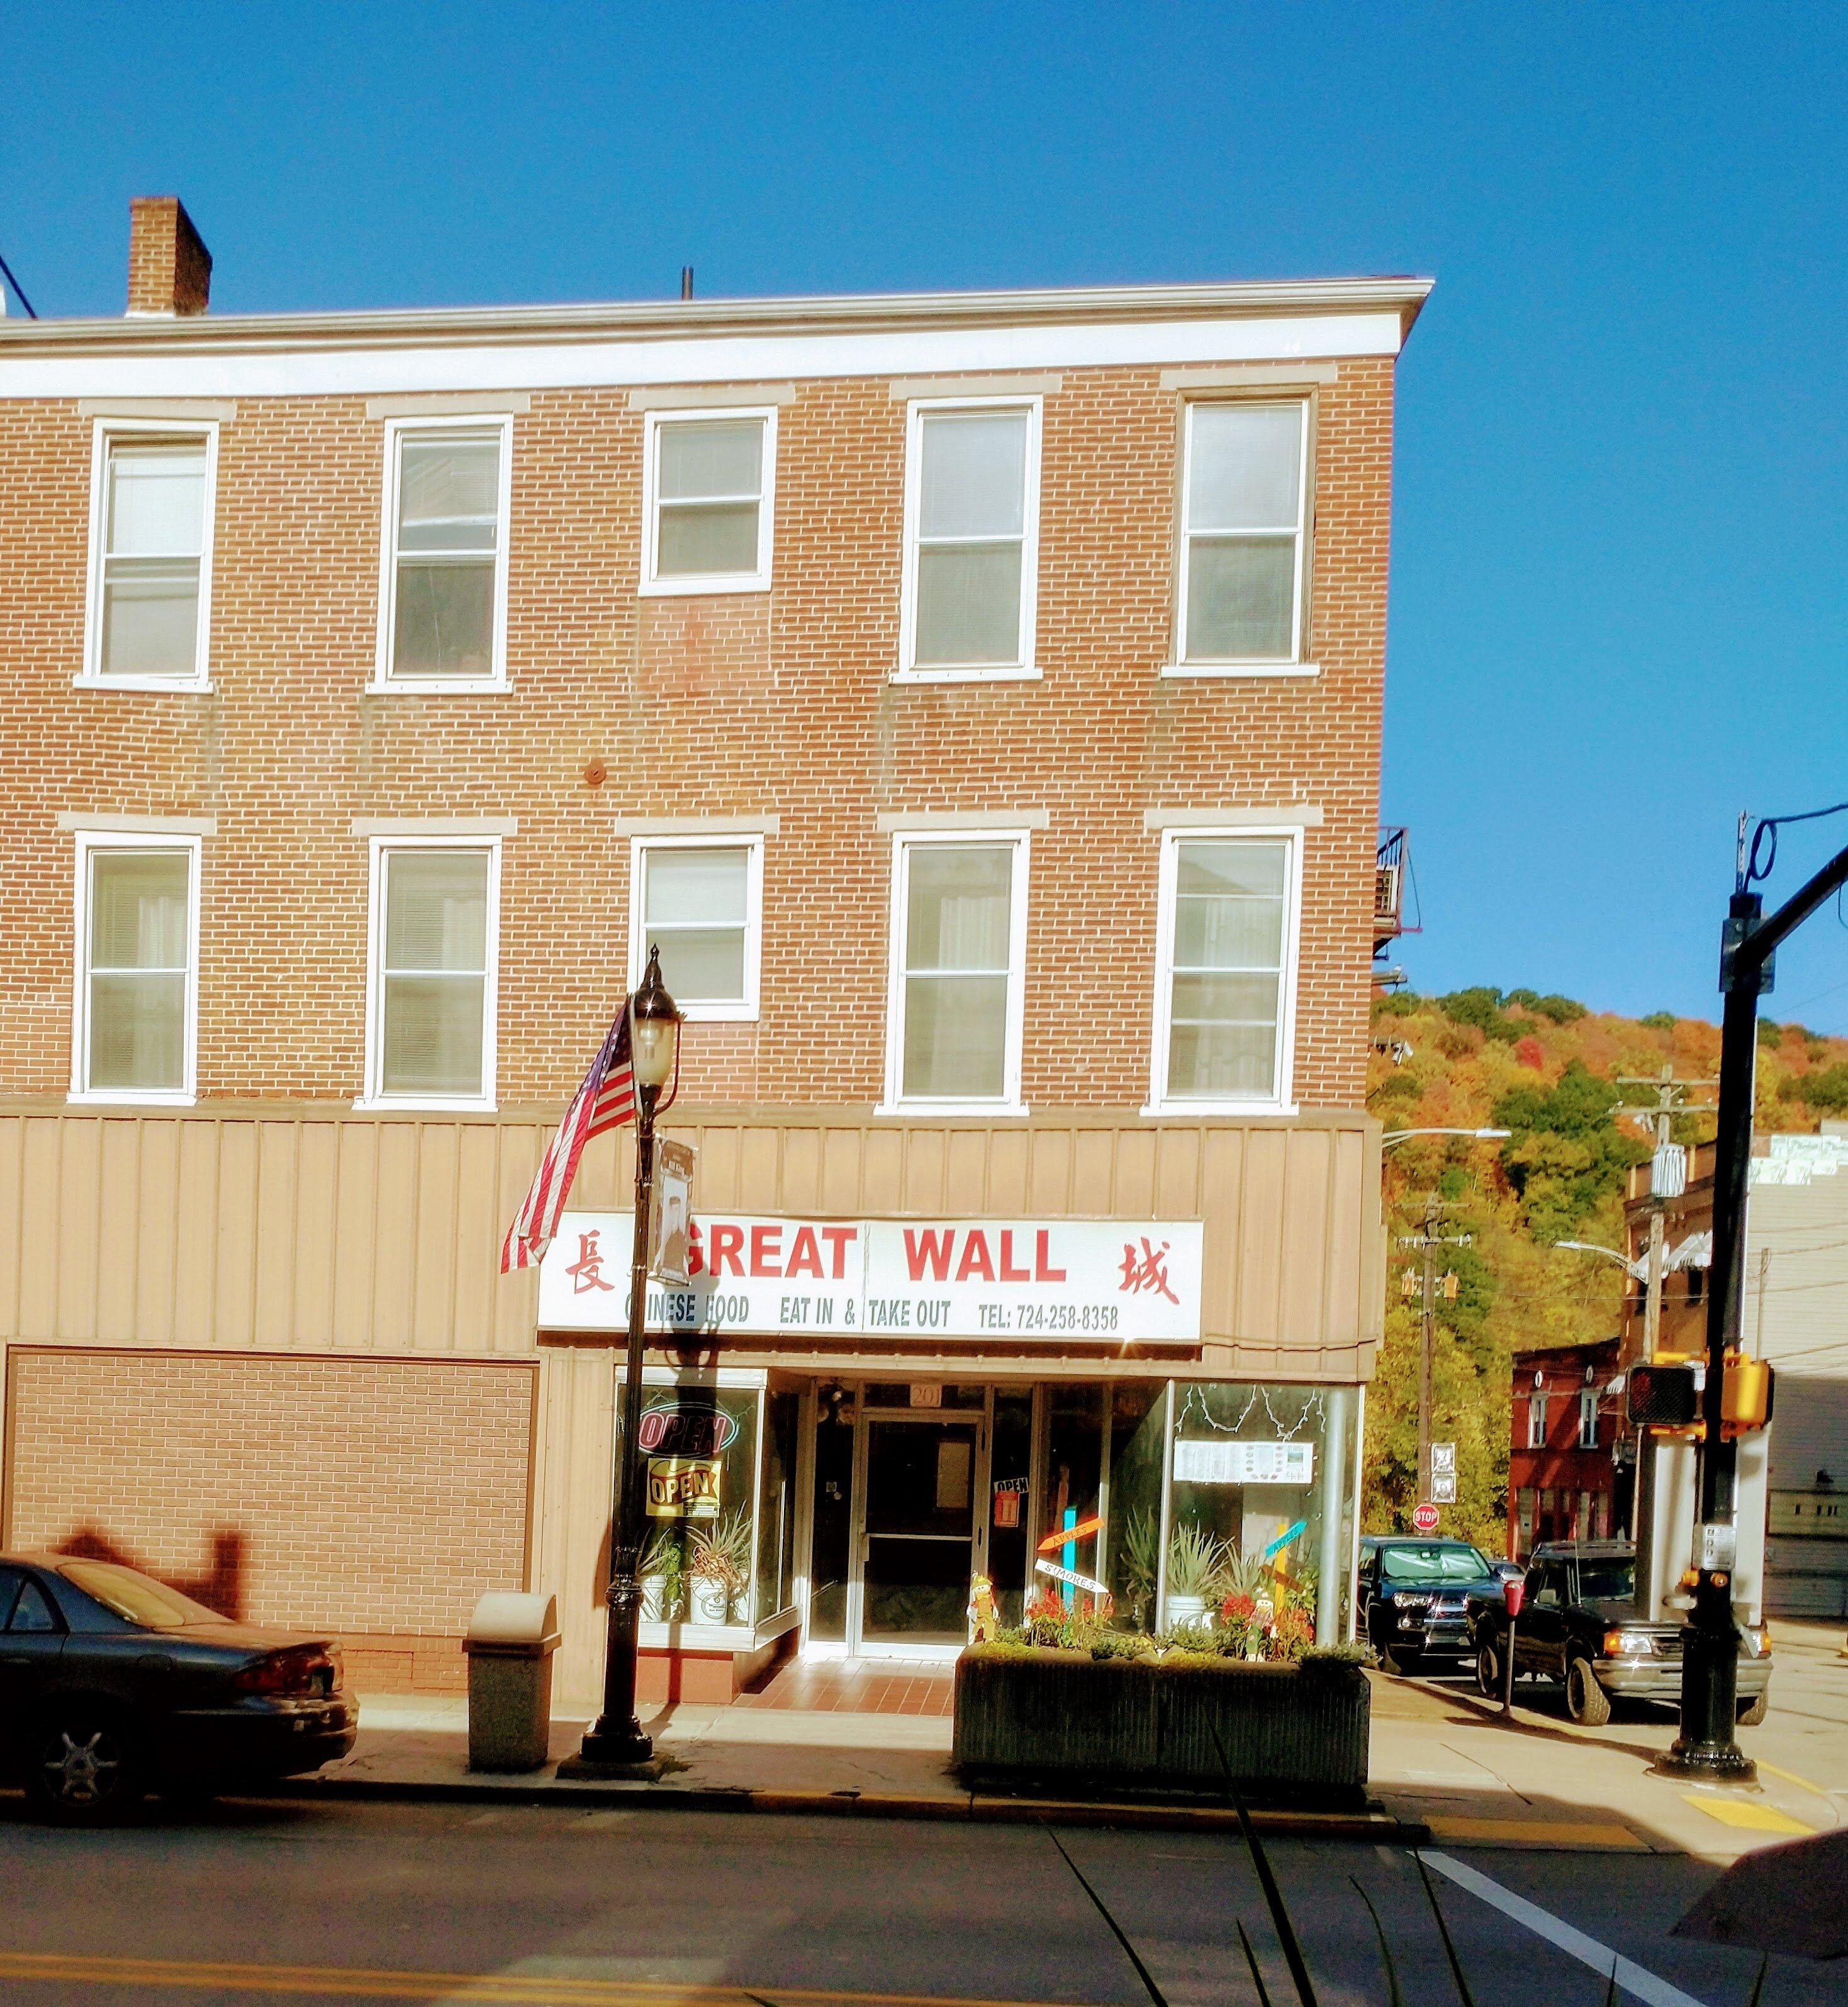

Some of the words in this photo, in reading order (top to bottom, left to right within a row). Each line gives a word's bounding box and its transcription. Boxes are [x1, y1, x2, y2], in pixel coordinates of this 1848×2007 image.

[565, 1229, 615, 1294] 長
[903, 1228, 1067, 1283] WALL
[1118, 1236, 1180, 1305] 城
[625, 1294, 696, 1321] CINESE
[705, 1294, 749, 1322] FOOD
[780, 1297, 811, 1324] EAT
[816, 1297, 833, 1325] IN
[844, 1297, 855, 1325] &
[868, 1299, 911, 1327] TAKE
[916, 1299, 951, 1328] OUT
[1017, 1304, 1119, 1331] 724-258-8358
[912, 1386, 940, 1404] 201
[639, 1412, 727, 1453] OPEN
[651, 1472, 710, 1504] OPEN
[997, 1477, 1028, 1492] OPEN
[1414, 1510, 1438, 1523] STOP
[1053, 1526, 1087, 1546] APPLES
